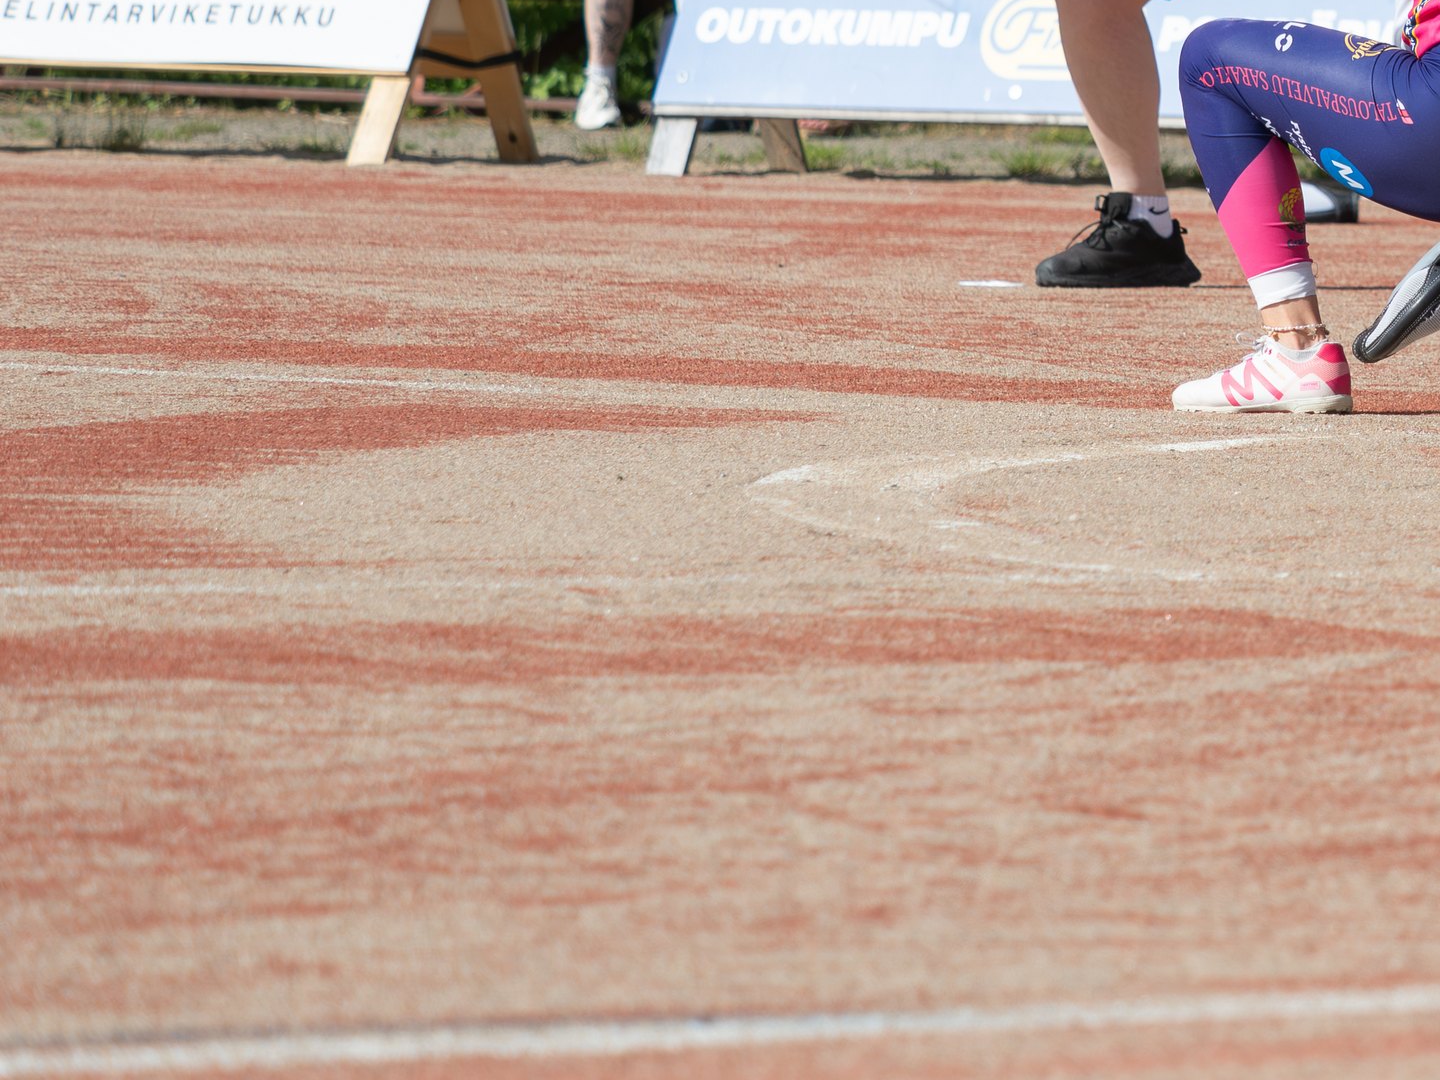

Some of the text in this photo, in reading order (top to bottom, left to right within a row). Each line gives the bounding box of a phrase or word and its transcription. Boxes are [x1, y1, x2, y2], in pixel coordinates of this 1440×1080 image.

[3, 0, 335, 27] ELINTARVIKETUKKU
[695, 6, 971, 48] OUTOKUMPU
[1271, 74, 1398, 122] TALOUSPALVELU
